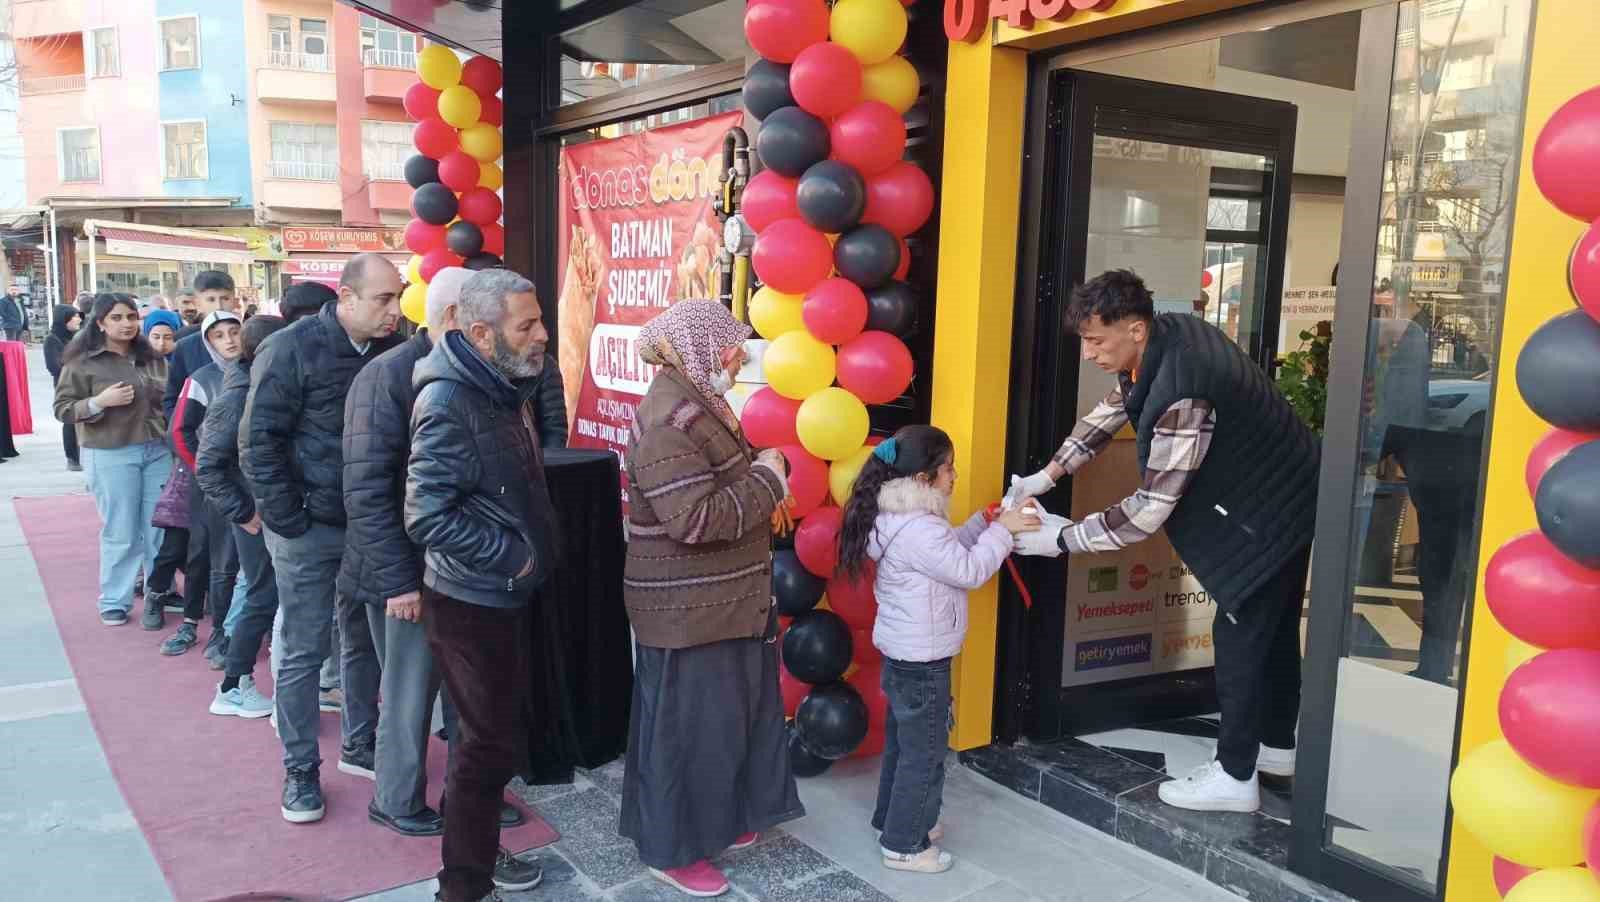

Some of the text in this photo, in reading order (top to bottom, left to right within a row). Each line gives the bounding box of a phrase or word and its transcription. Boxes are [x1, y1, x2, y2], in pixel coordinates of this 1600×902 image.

[571, 148, 723, 209] donas döne
[611, 216, 673, 258] BATMAN
[607, 260, 672, 315] ŞUBEMİZ
[595, 335, 657, 385] AÇILI
[577, 418, 597, 438] DONAS
[1077, 599, 1153, 622] Yemeksepeti
[1078, 640, 1149, 665] getiryemek
[1161, 632, 1211, 659] yeme
